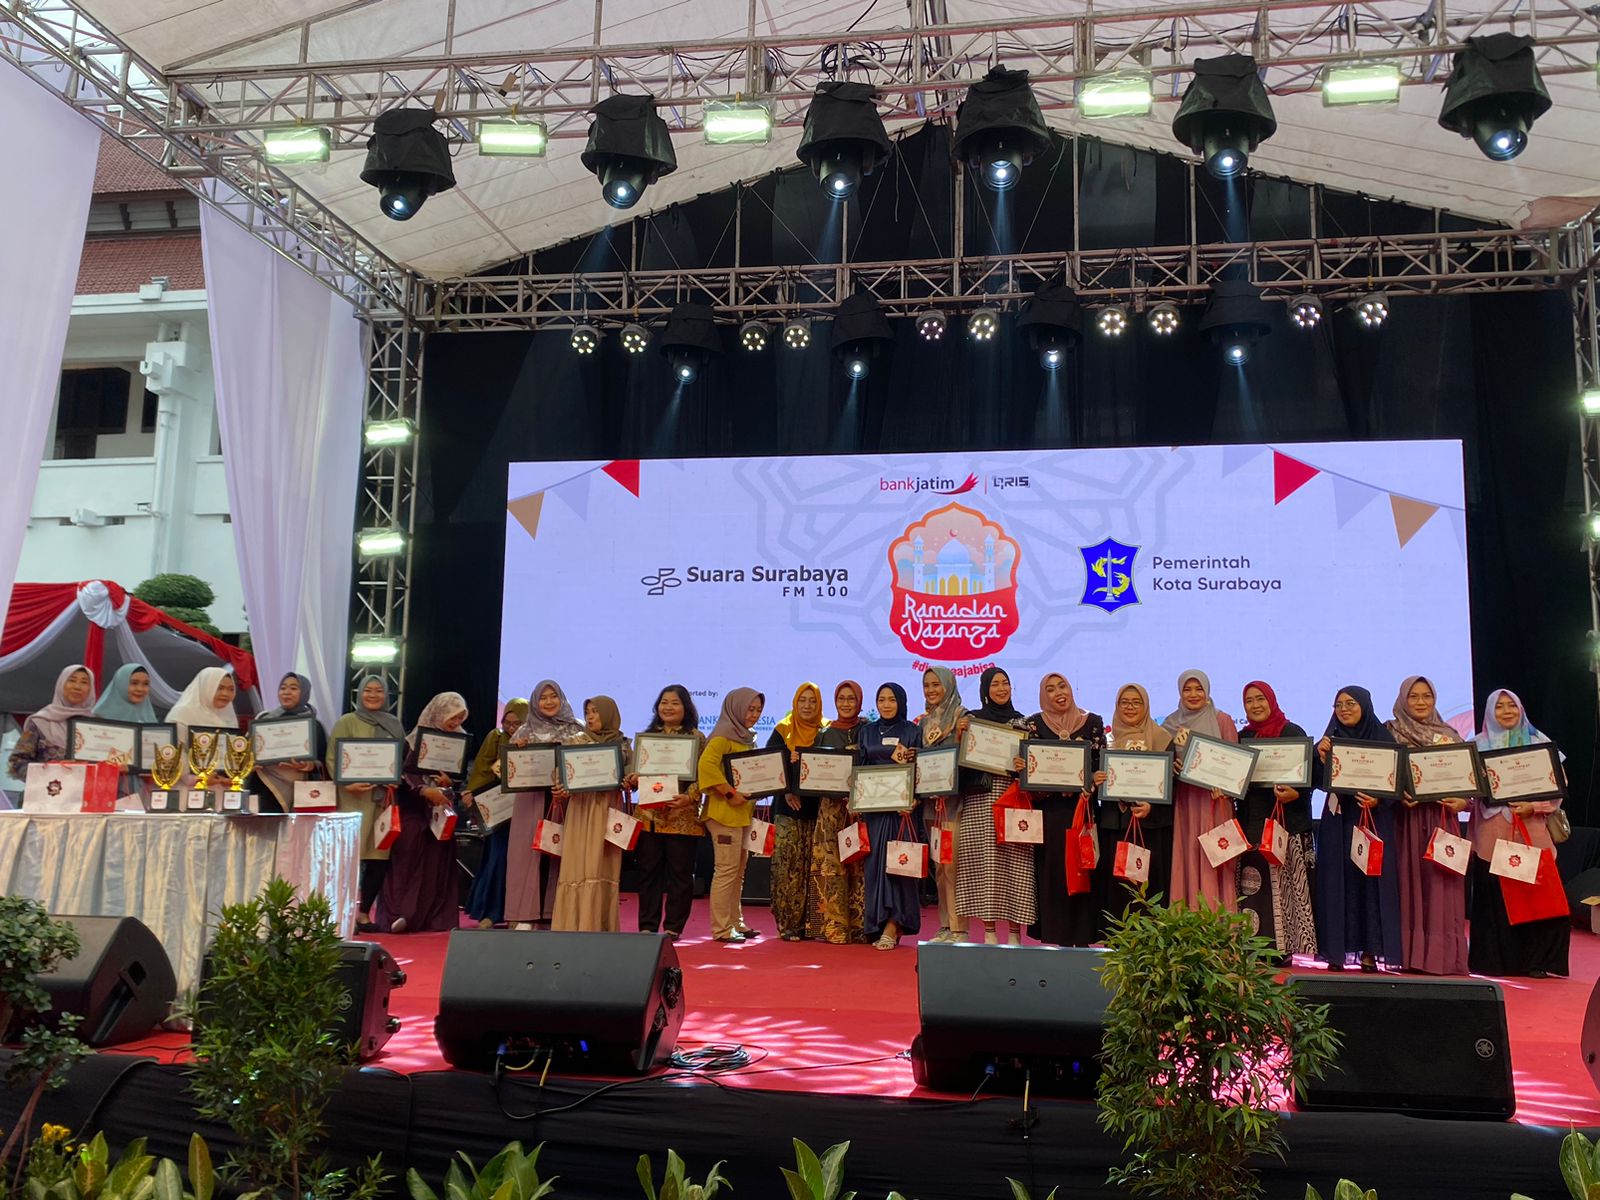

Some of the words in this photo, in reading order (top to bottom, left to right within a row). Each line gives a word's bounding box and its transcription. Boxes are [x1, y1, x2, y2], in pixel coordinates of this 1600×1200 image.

[993, 476, 1030, 490] QRIS
[1153, 555, 1251, 569] Pemerintah
[687, 566, 745, 583] Suara
[751, 565, 849, 585] Surabaya
[782, 586, 805, 597] FM
[816, 586, 849, 597] 100
[1153, 577, 1192, 591] Kota
[1198, 577, 1282, 593] Surabaya
[901, 593, 1008, 622] Ramadan
[900, 617, 1001, 650] Vaganza
[897, 751, 908, 762] 86
